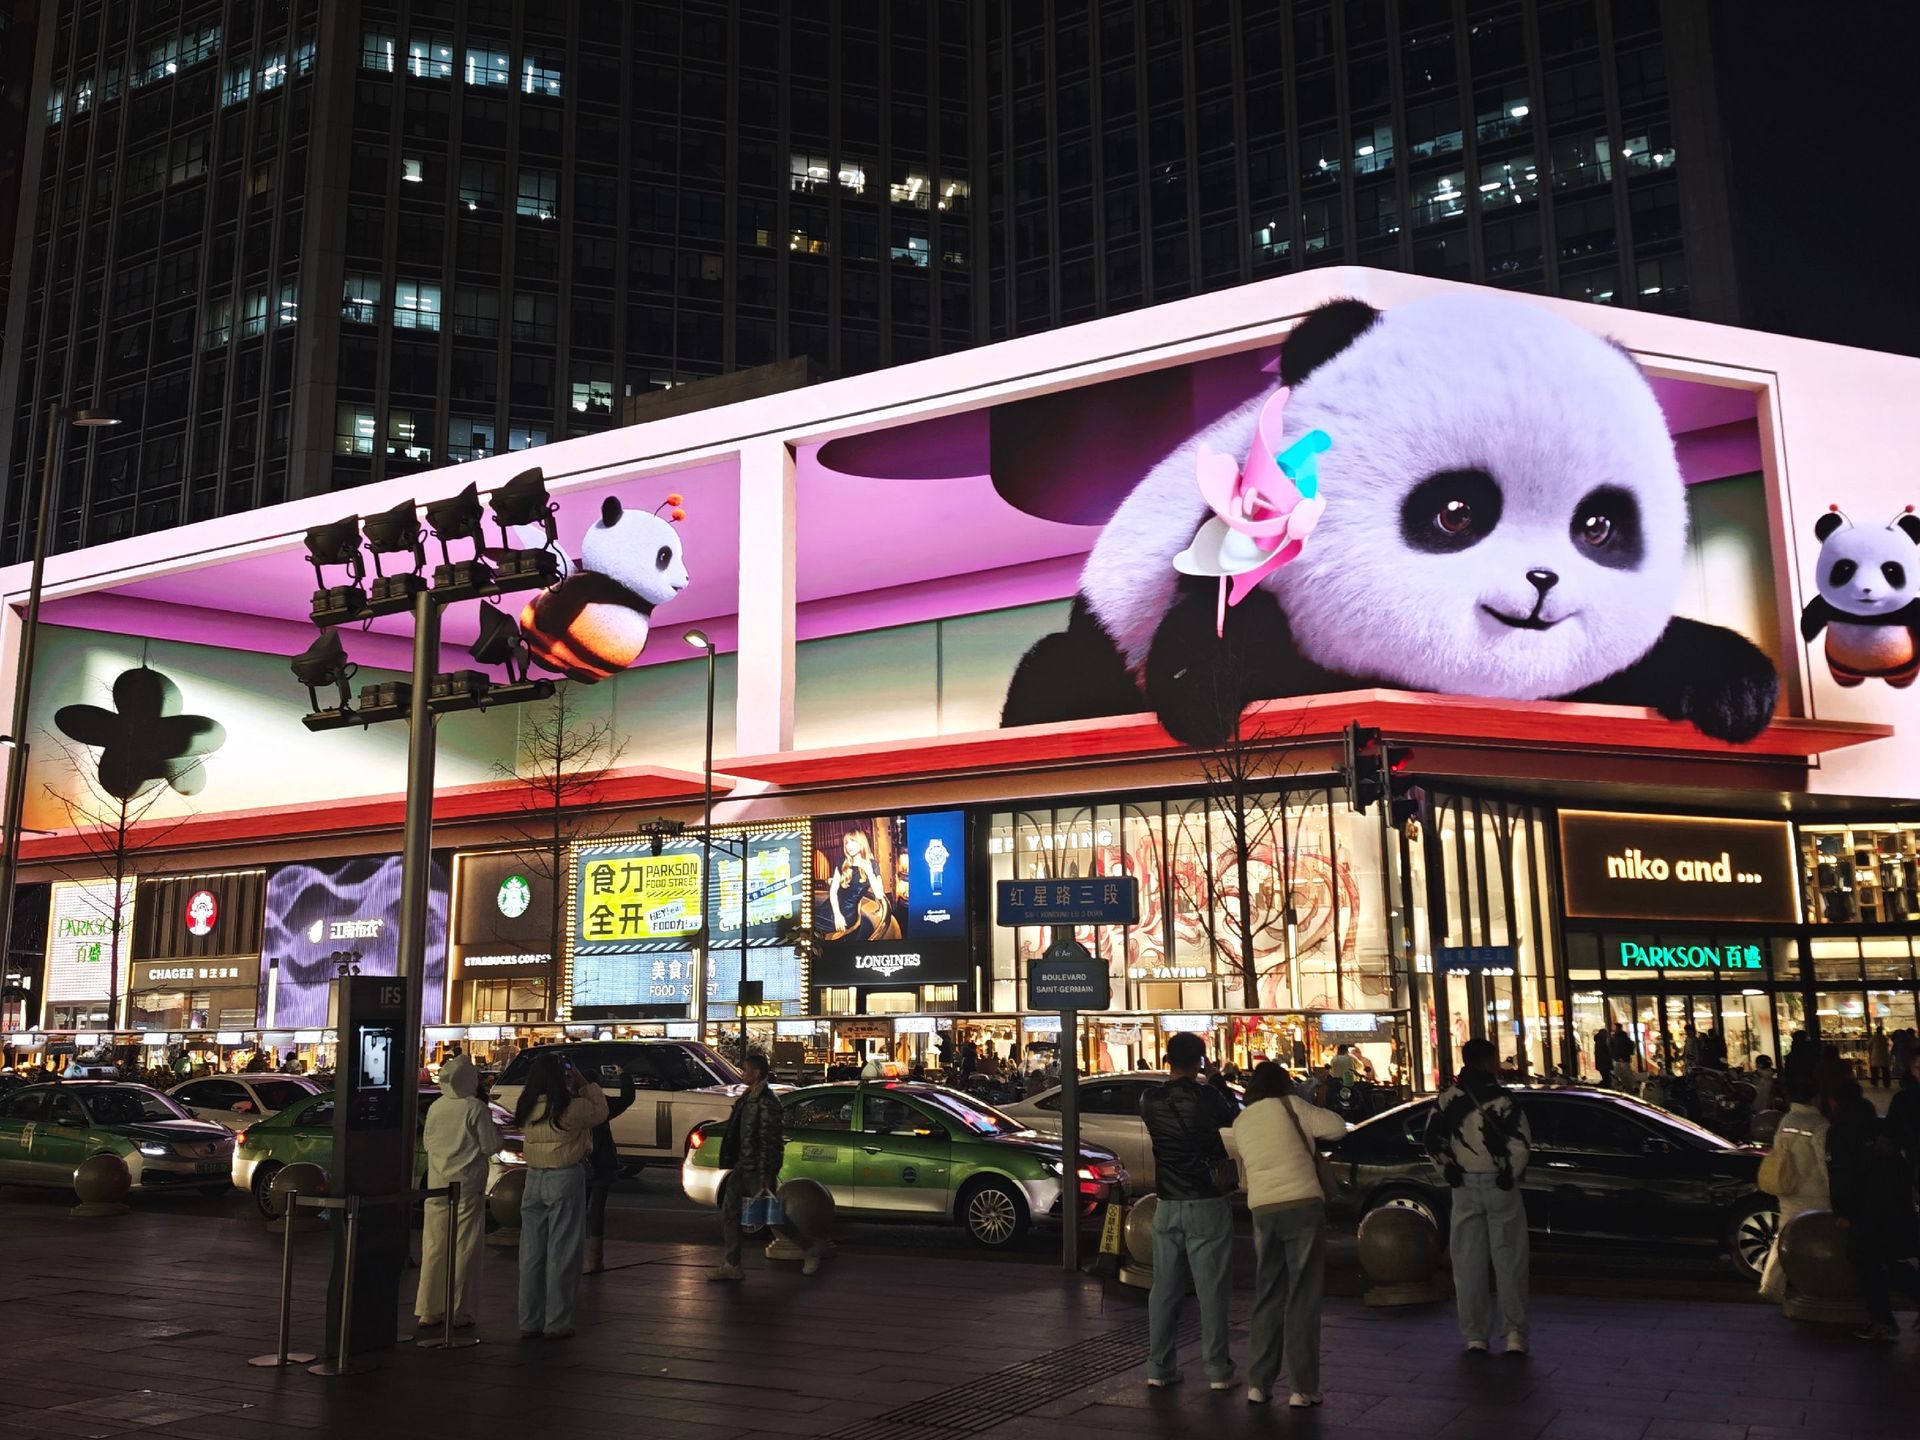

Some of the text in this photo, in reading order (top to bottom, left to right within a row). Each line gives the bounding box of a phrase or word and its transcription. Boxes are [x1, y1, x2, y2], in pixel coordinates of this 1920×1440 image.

[646, 862, 698, 878] PARKSON
[1607, 848, 1670, 881] niko
[1675, 852, 1732, 883] and
[591, 862, 643, 895] 食力
[646, 877, 698, 889] FOOD STREET
[1010, 883, 1119, 907] 红星路三段
[589, 903, 644, 936] 全开
[464, 955, 517, 967] STARBUCKS
[855, 953, 921, 969] LONGINES
[1620, 942, 1763, 969] PARKSON 百盛
[149, 968, 194, 980] CHAGEE
[1042, 974, 1087, 982] BOULEVARD
[380, 986, 401, 1005] IFS
[649, 984, 676, 997] FOOD
[1036, 985, 1094, 994] SAINT-GERMAIN
